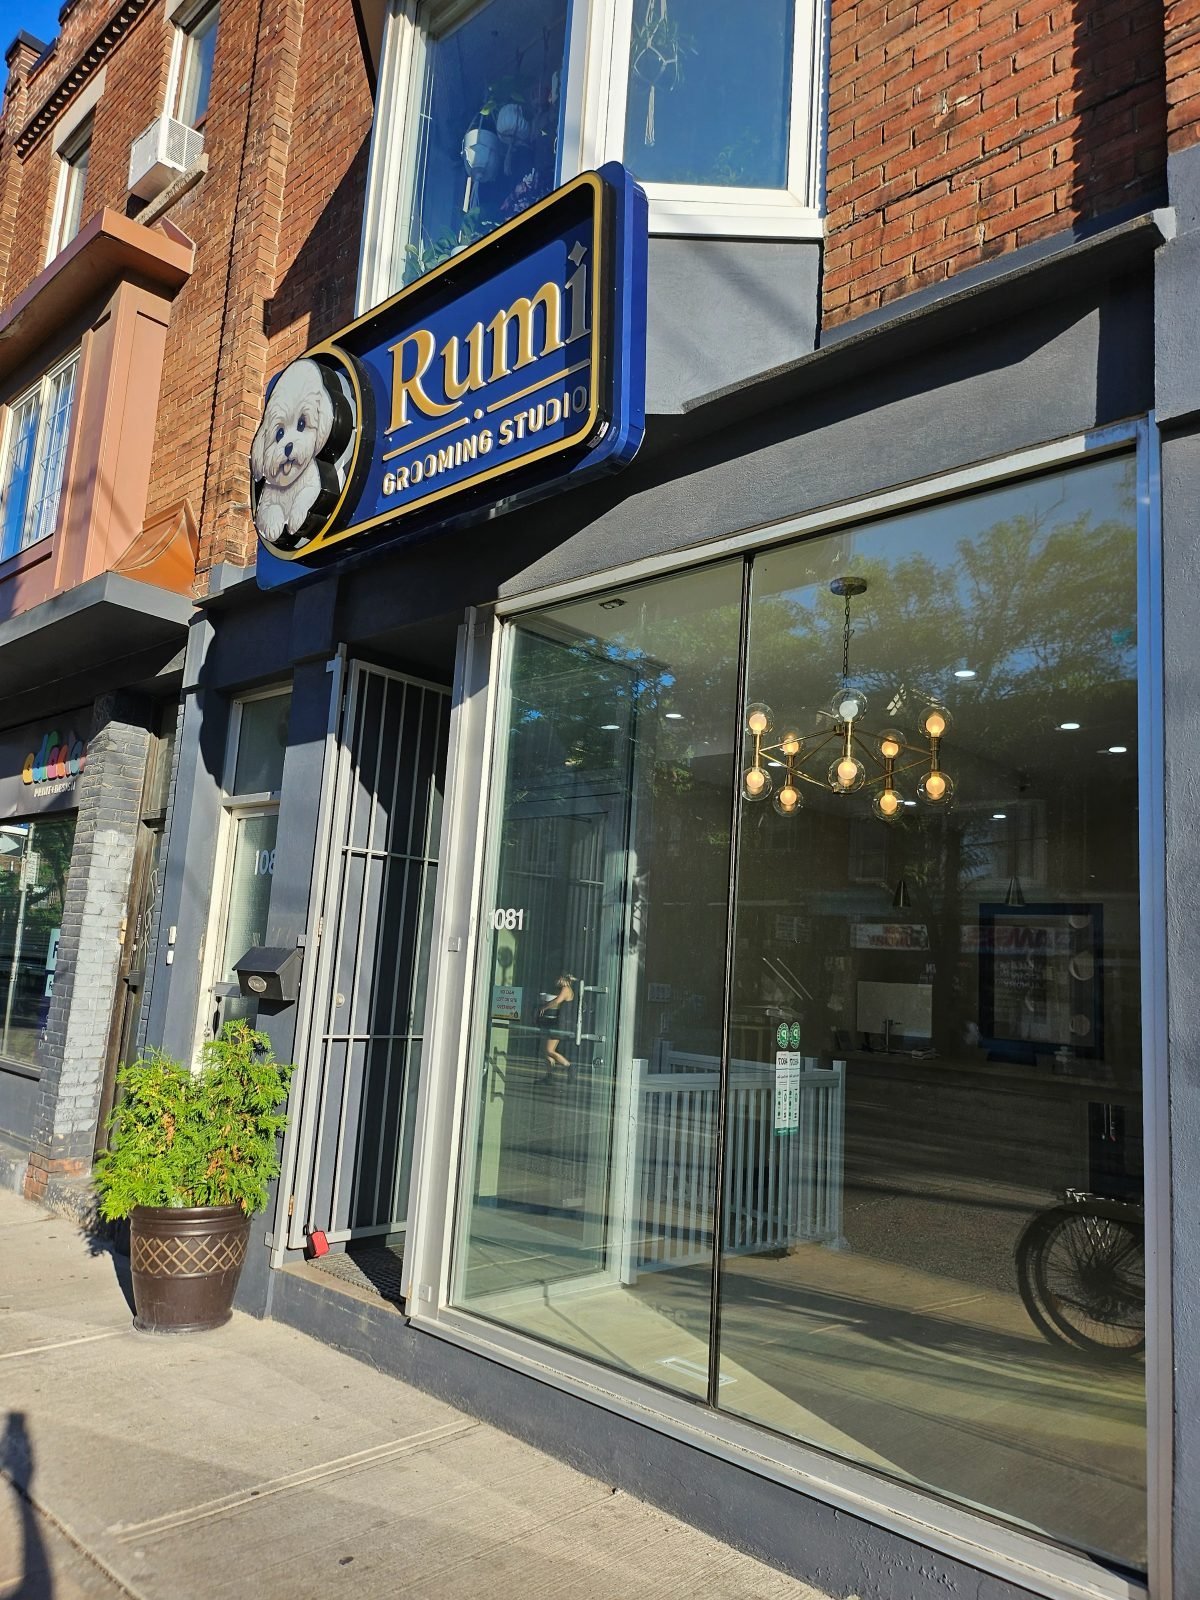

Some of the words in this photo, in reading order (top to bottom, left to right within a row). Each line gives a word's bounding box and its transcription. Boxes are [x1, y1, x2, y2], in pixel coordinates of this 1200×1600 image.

[384, 241, 591, 435] Rumi
[383, 429, 493, 496] GROOMING
[499, 386, 588, 446] STUDIO
[489, 908, 524, 931] 1081
